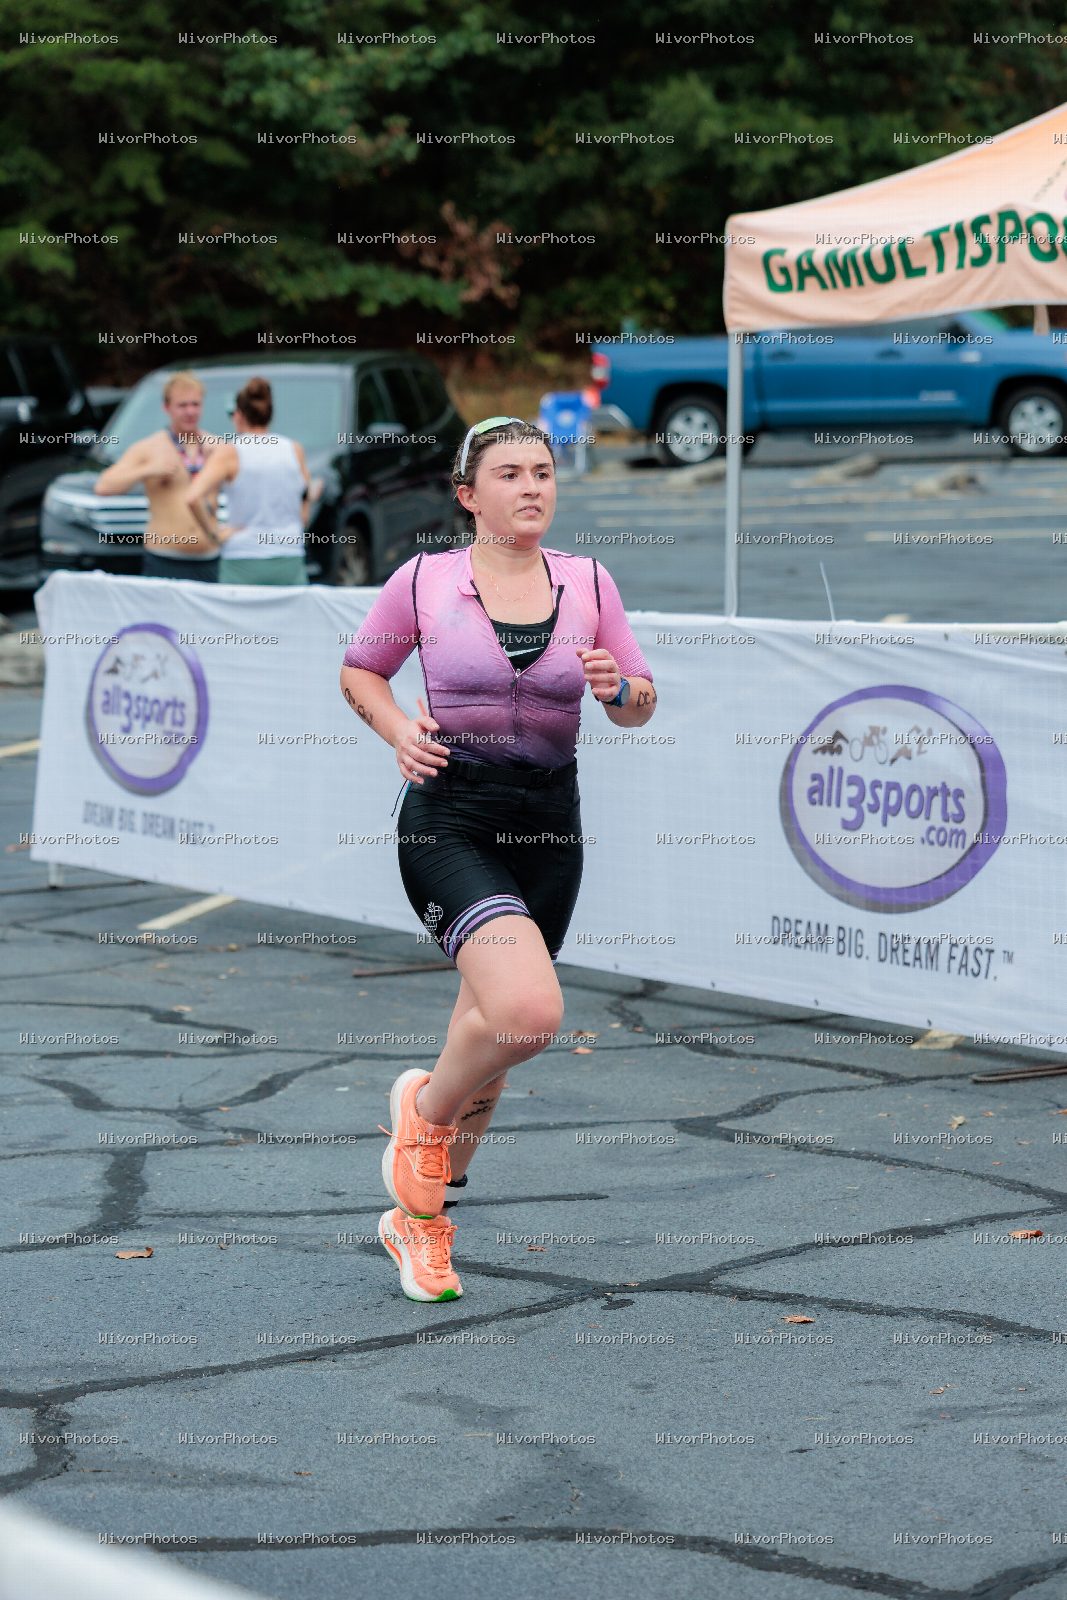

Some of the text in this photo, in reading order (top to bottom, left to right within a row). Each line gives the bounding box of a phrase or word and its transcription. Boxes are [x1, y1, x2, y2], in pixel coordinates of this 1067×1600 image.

[761, 209, 1067, 294] GAMULTISPO
[807, 765, 966, 832] all3sports
[920, 825, 967, 850] .com
[771, 915, 829, 954] DREAM
[836, 925, 870, 961] BIG.
[877, 932, 939, 972] DREAM
[946, 941, 999, 982] FAST.
